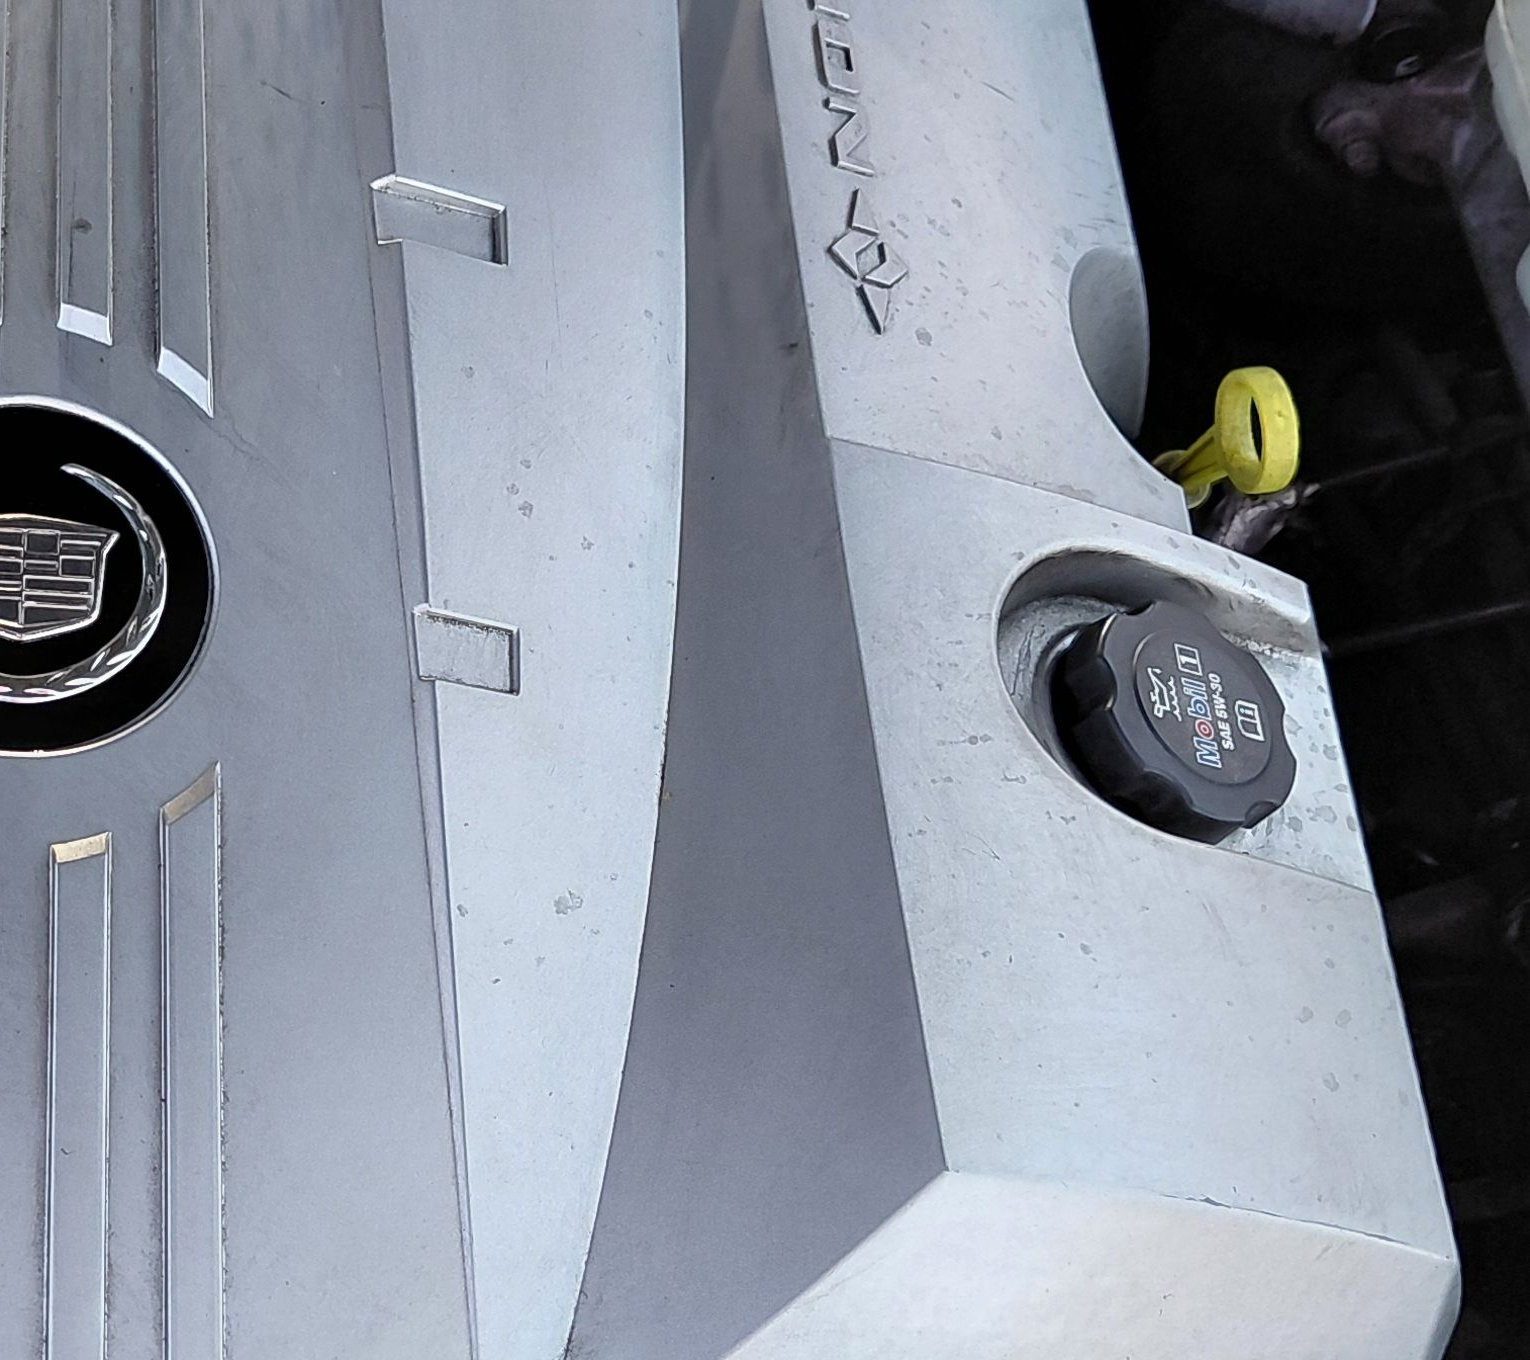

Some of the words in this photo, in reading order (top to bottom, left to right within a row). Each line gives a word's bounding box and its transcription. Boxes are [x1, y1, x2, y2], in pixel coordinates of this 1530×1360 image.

[1208, 672, 1228, 720] 5W-30
[1180, 676, 1222, 769] Mobil
[1218, 720, 1235, 751] SAE
